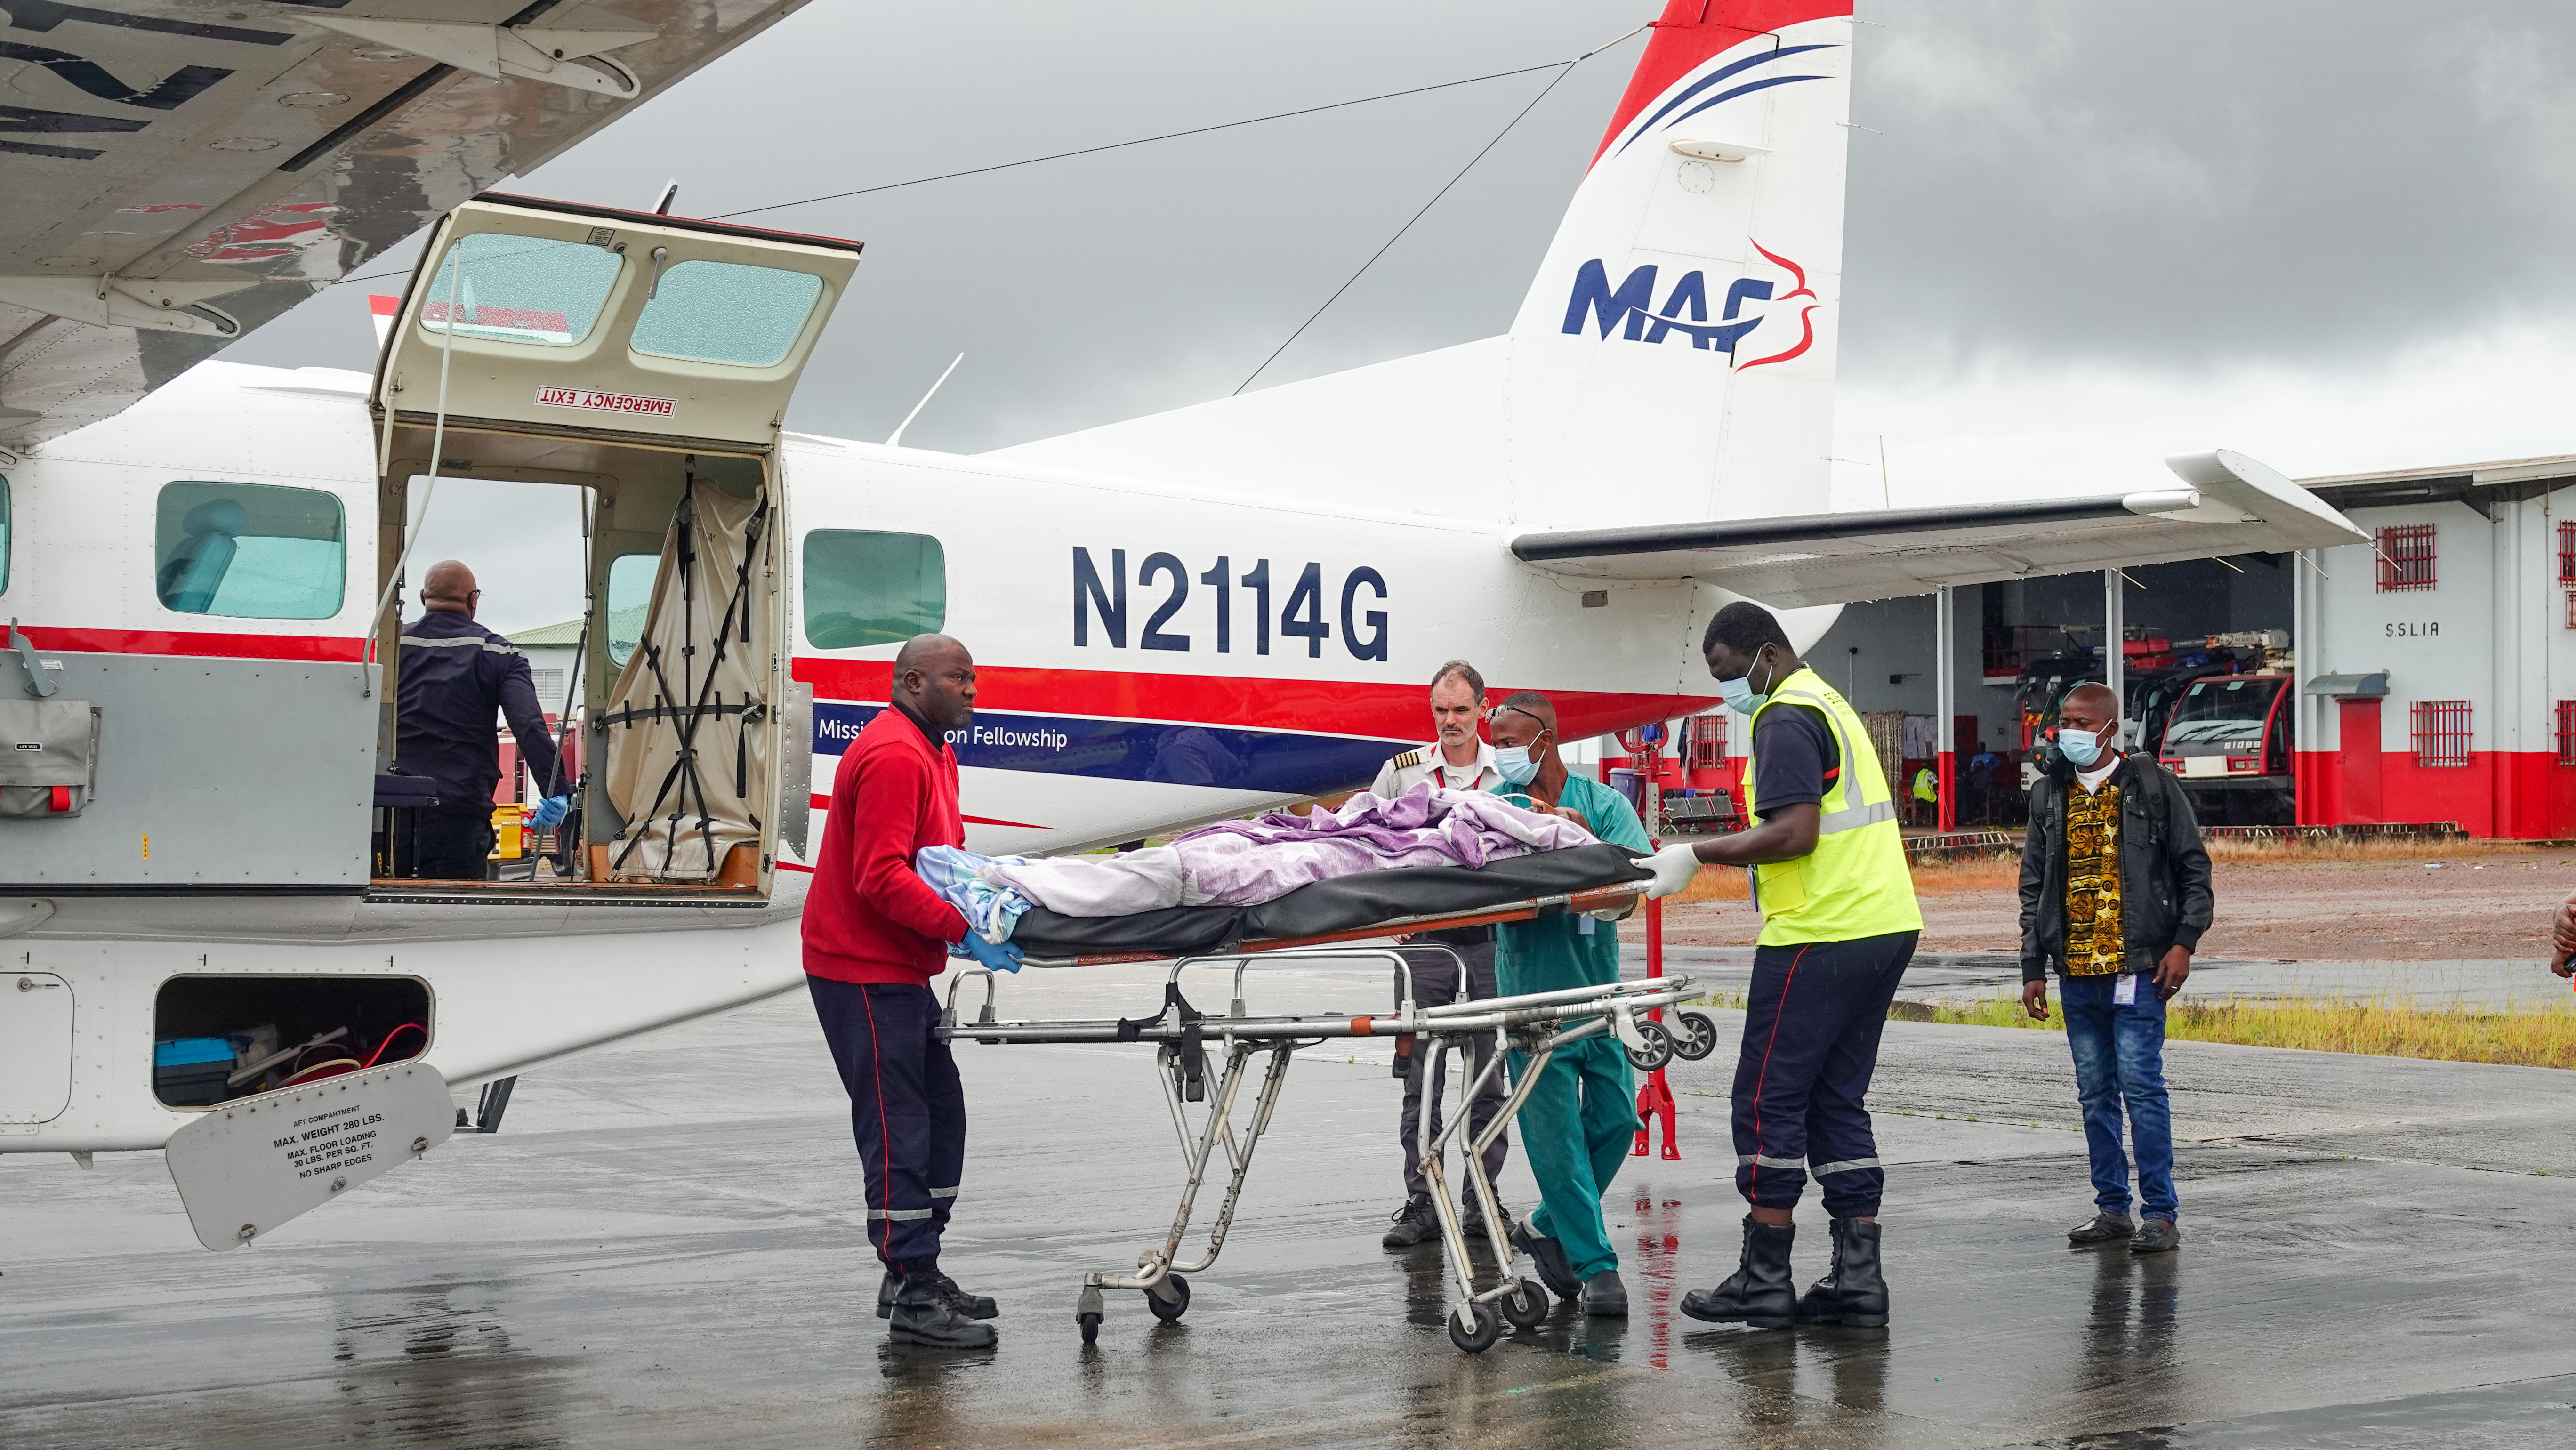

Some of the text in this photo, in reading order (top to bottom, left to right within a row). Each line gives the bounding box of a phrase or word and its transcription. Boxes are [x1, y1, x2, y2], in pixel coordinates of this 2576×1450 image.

[1561, 258, 1774, 353] MAF
[540, 389, 673, 414] EMERGENCY EXIT
[1072, 546, 1388, 661] N2114G
[819, 719, 864, 740] Missi
[974, 726, 1068, 752] Fellowship
[274, 1113, 385, 1148] MAX. WEIGHT 280 LBS.
[293, 1105, 360, 1128] AFT COMPARTMENT
[287, 1130, 377, 1160] MAX. FLOOR LOADING
[294, 1141, 373, 1168] 30 LBS. PER SQ. FT.
[299, 1154, 372, 1179] NO SHARP EDGES
